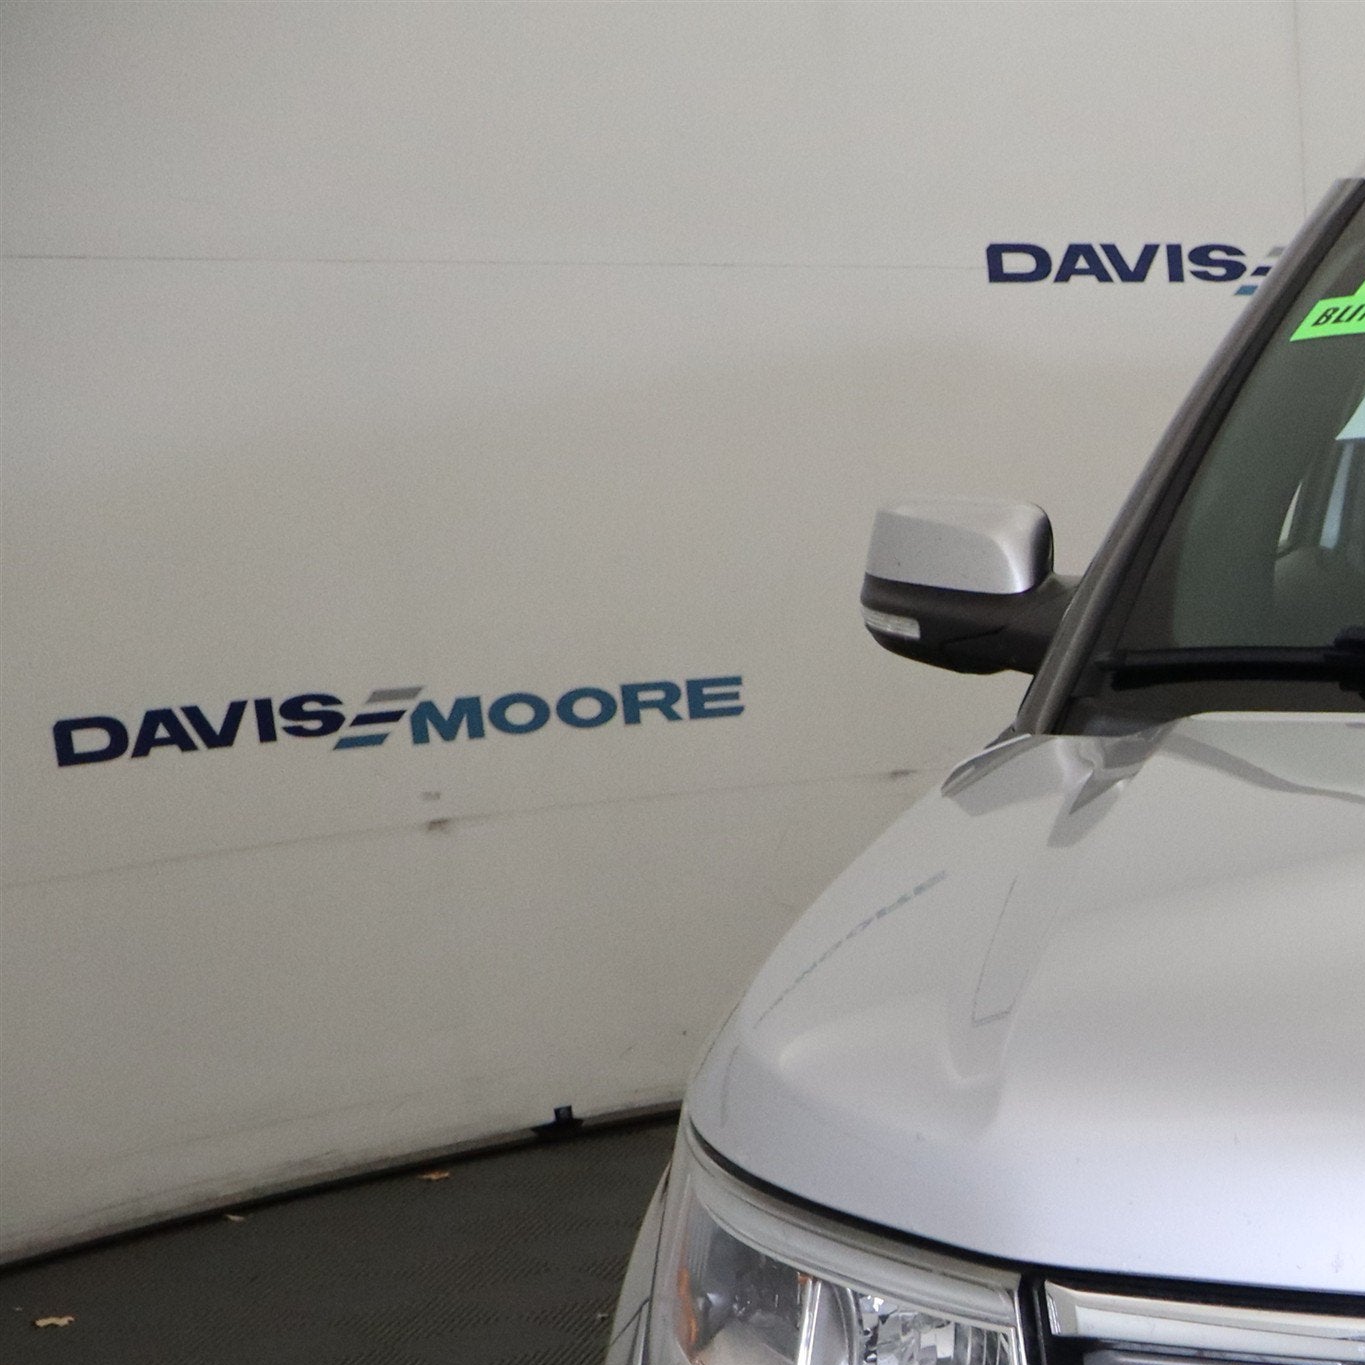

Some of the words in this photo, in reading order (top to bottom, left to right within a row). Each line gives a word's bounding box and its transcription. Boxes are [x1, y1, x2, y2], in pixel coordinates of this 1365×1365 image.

[986, 243, 1247, 283] DAVIS
[52, 691, 346, 768] DAVIS
[410, 675, 746, 746] MOORE
